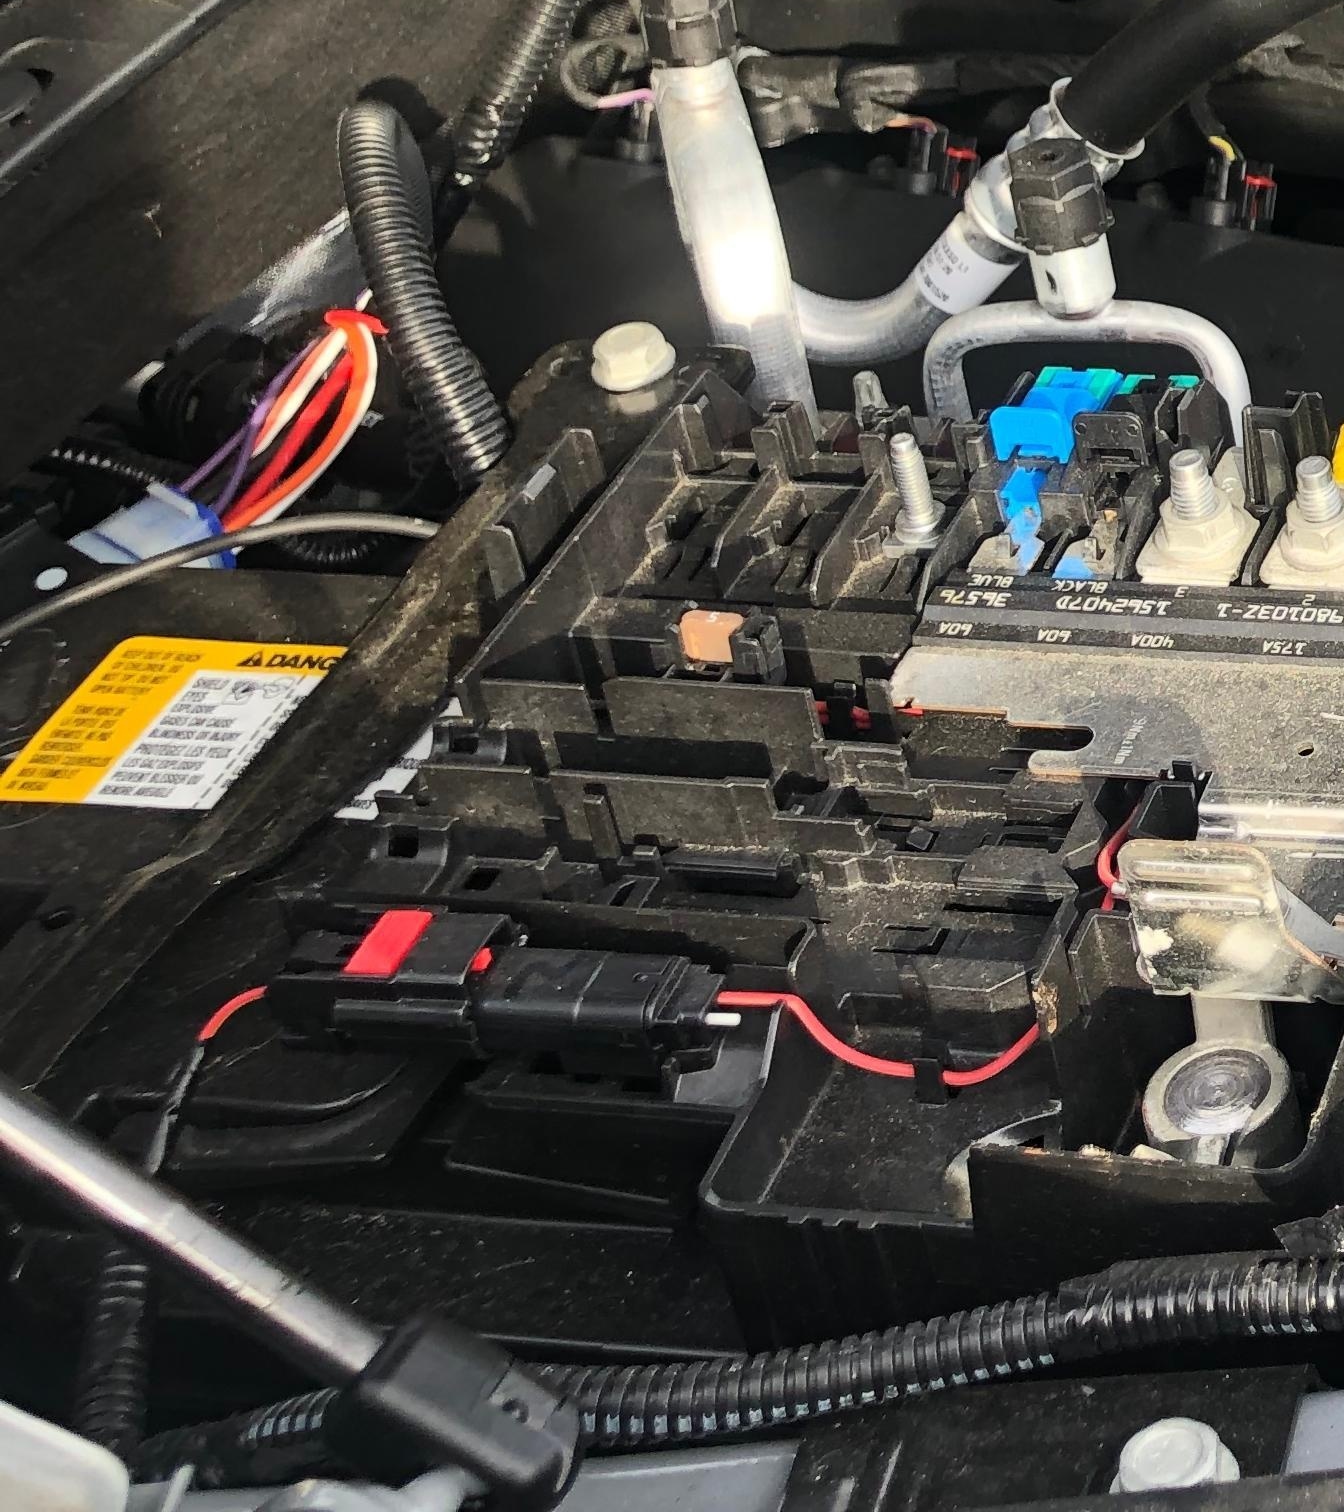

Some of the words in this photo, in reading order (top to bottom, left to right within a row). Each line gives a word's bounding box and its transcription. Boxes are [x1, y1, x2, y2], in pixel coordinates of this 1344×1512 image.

[968, 573, 1014, 588] BLUE
[1053, 579, 1109, 593] BLACK
[940, 588, 1012, 608] 36576
[938, 621, 974, 637] 60A
[1037, 628, 1072, 643] 60A
[1130, 633, 1175, 648] 400A
[1262, 639, 1308, 656] 175A
